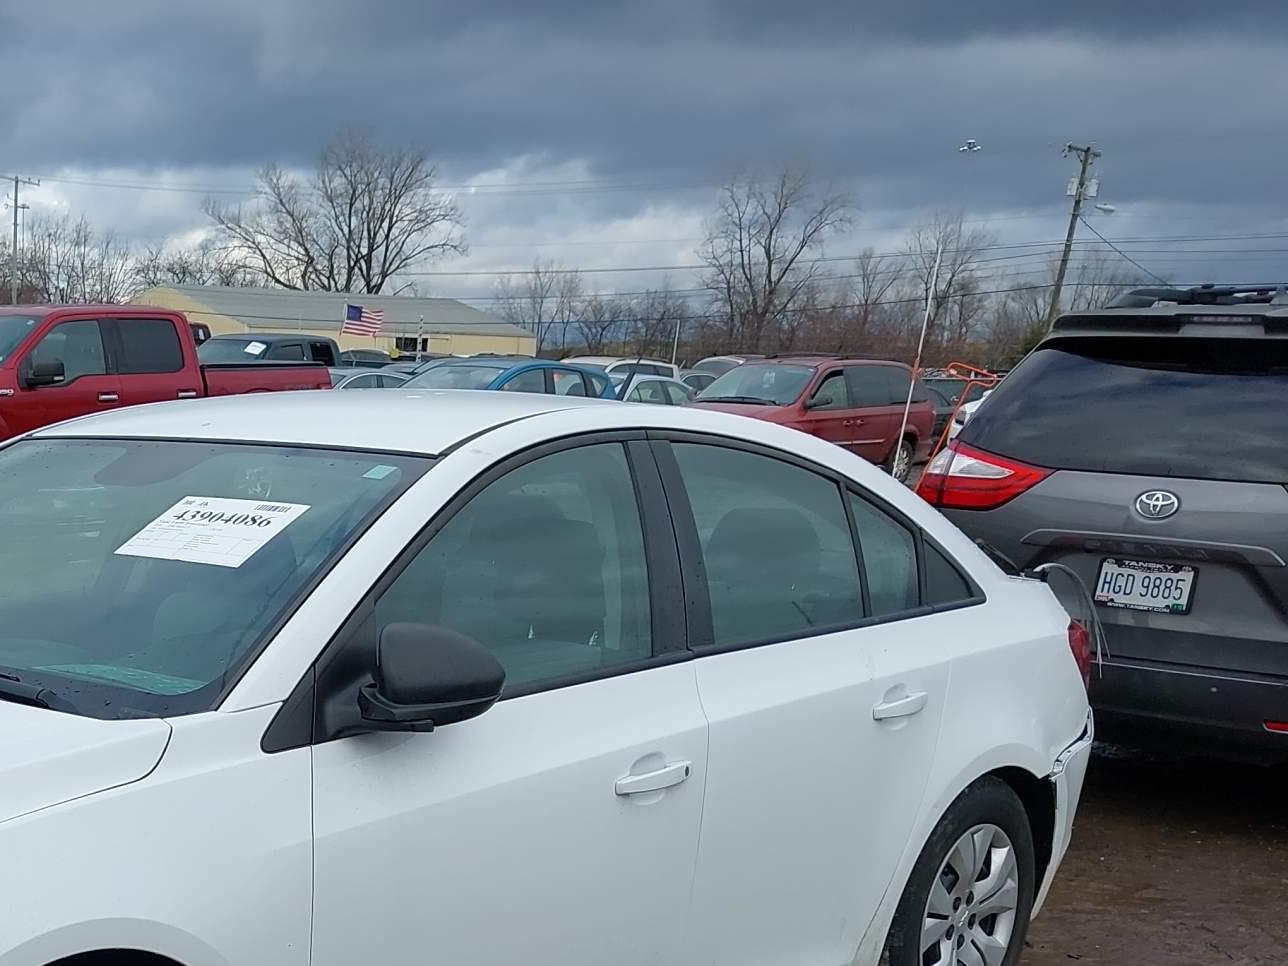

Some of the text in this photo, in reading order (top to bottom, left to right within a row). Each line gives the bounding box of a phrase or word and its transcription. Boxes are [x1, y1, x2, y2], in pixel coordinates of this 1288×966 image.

[173, 509, 275, 528] 43904086
[1100, 571, 1186, 601] HGD 9885
